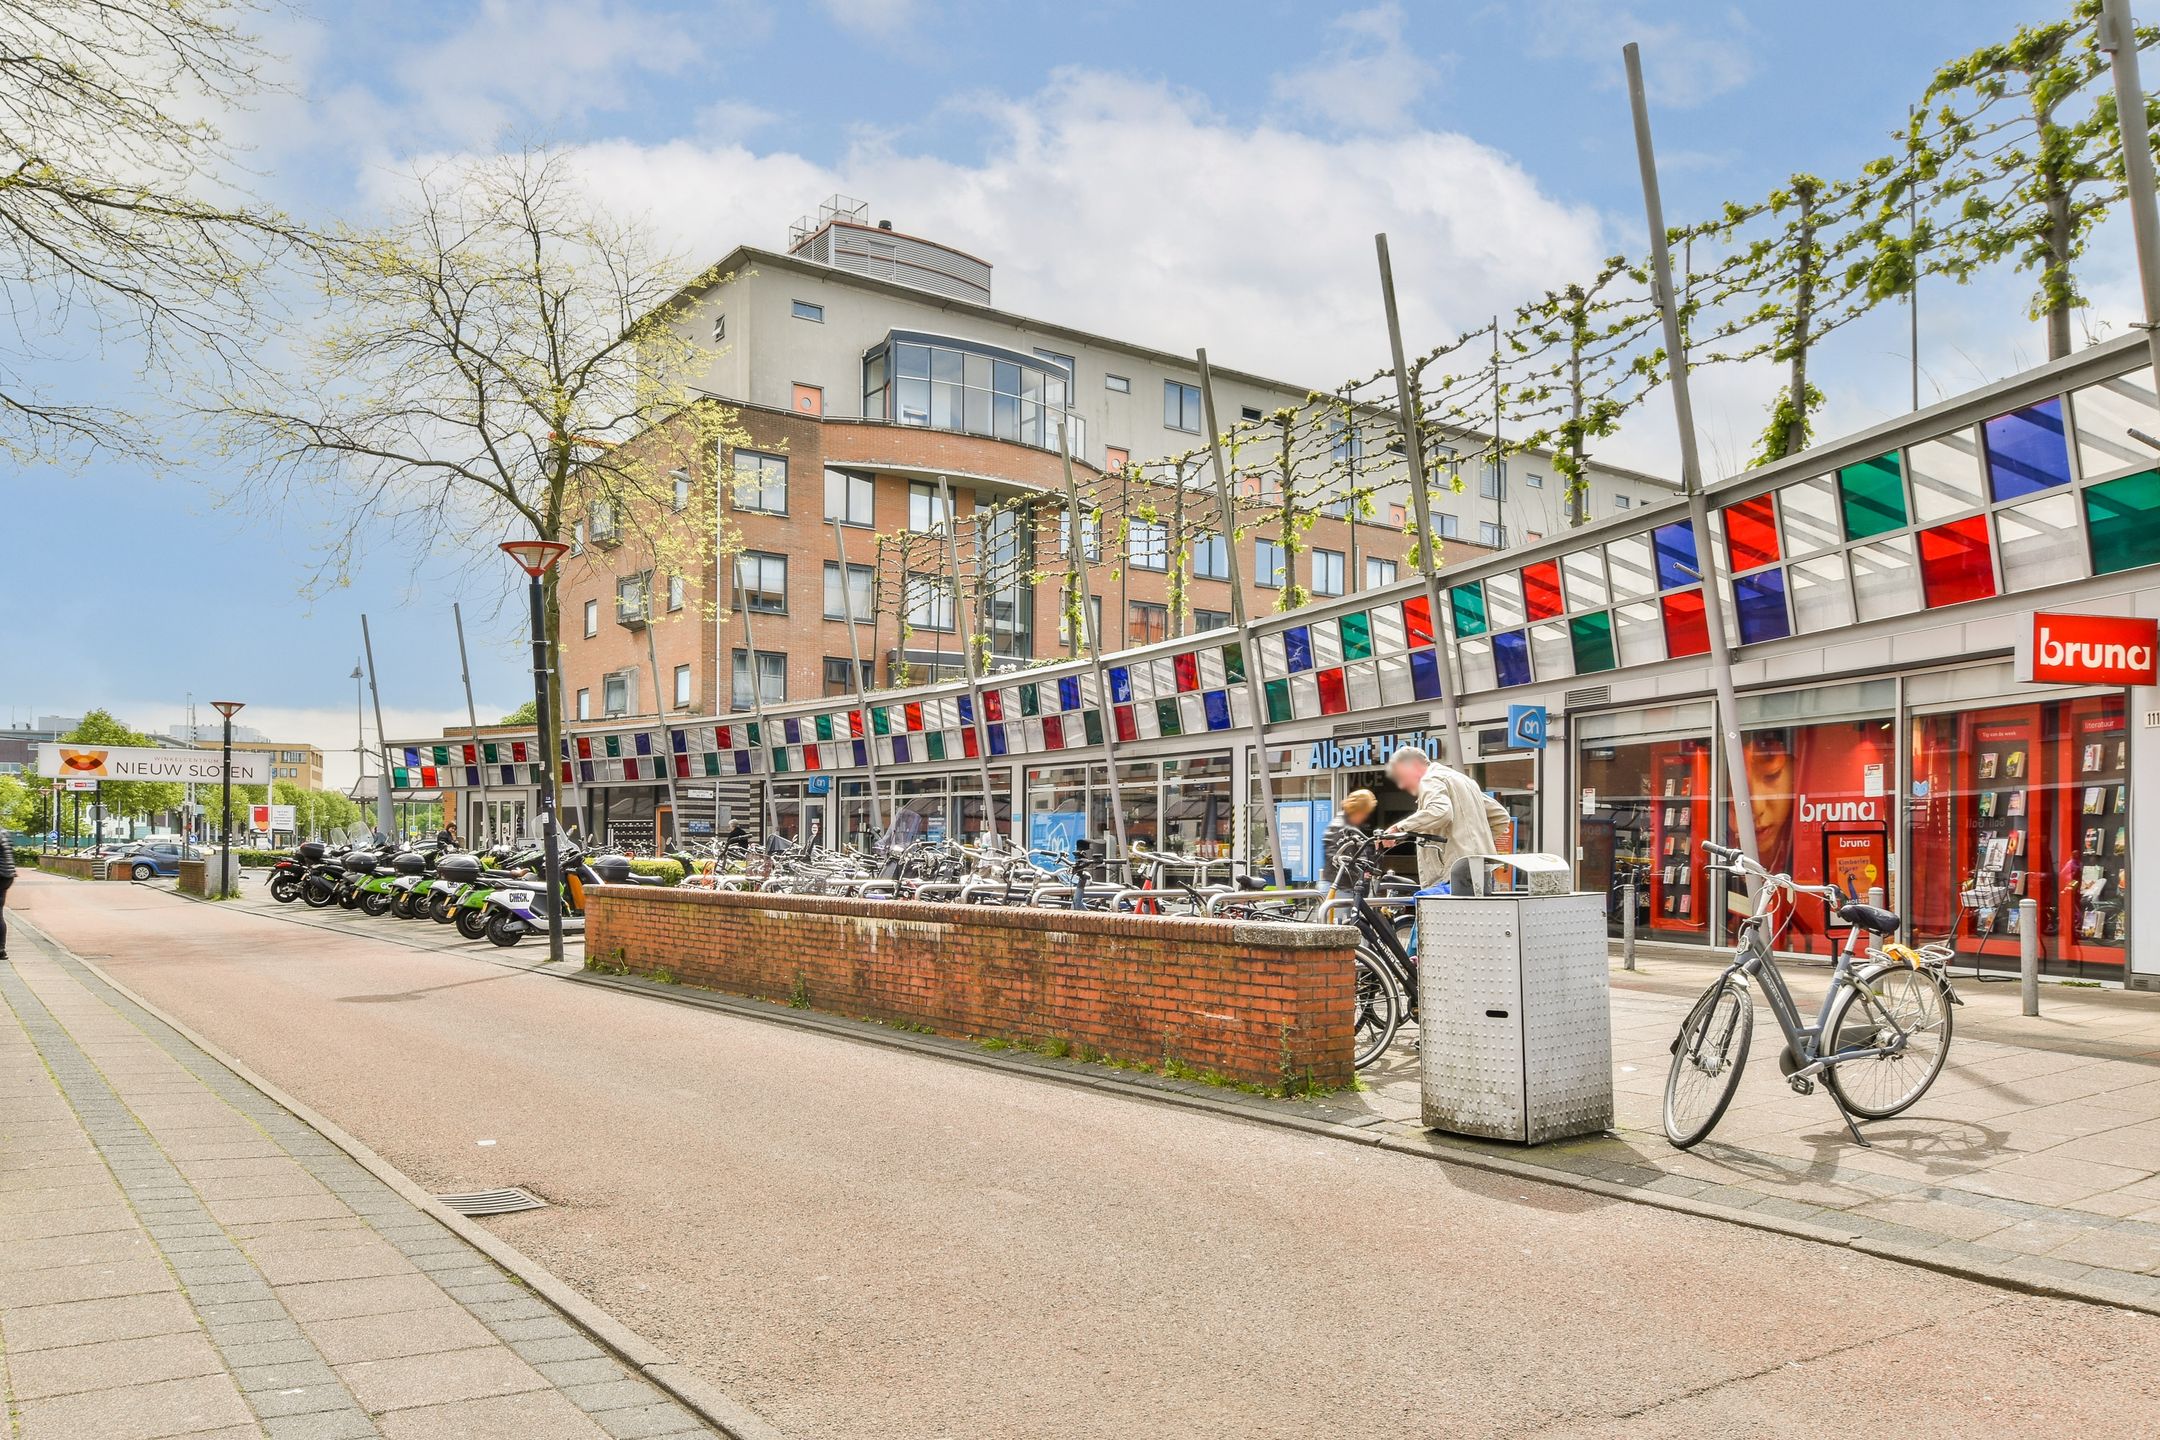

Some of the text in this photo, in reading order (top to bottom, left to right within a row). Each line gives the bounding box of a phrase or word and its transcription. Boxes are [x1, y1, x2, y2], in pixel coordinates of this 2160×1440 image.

[2040, 627, 2151, 671] bruna
[2084, 720, 2115, 729] literatuur
[153, 755, 219, 763] WINKELCENTRUM
[1309, 739, 1372, 769] Albert
[116, 761, 182, 776] NIEUW
[1800, 794, 1875, 822] bruna
[1840, 837, 1871, 848] bruna
[1762, 972, 1784, 1009] GAZELLE
